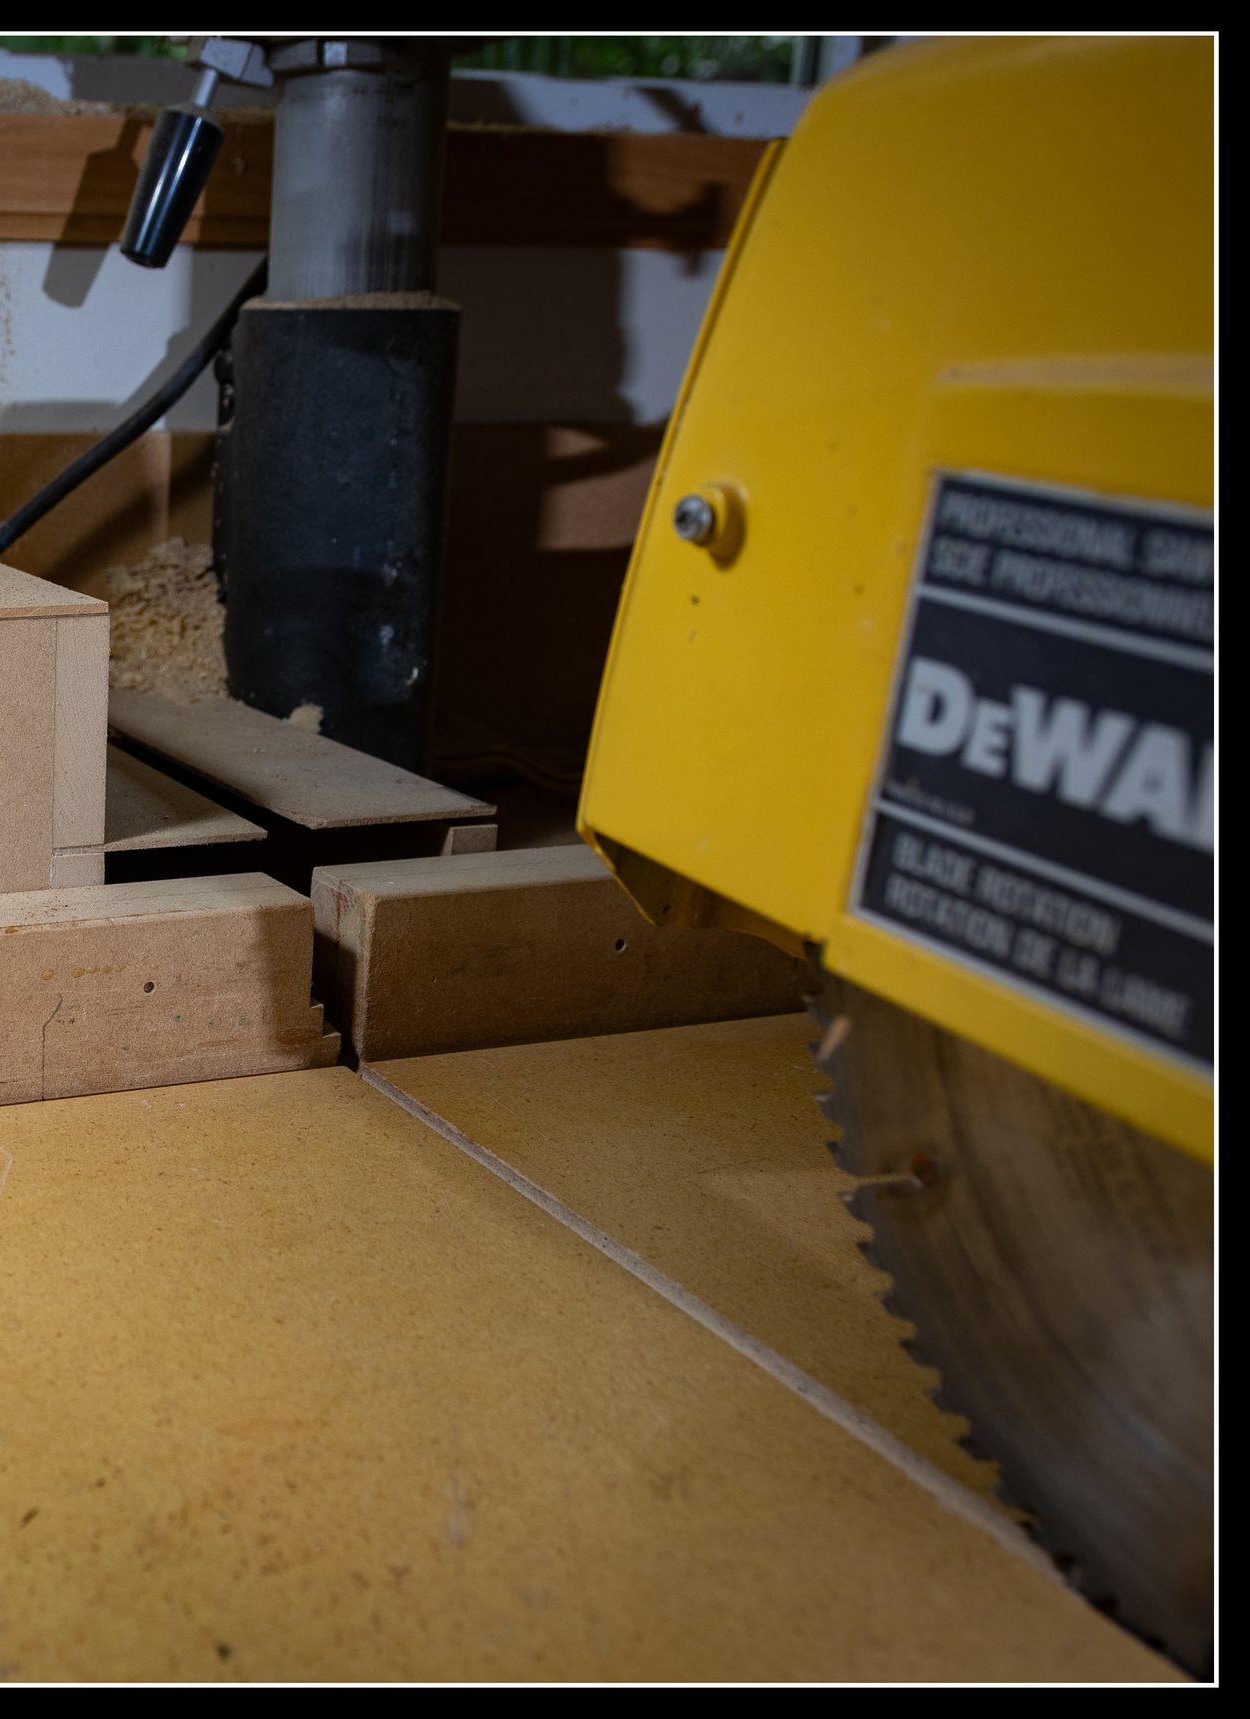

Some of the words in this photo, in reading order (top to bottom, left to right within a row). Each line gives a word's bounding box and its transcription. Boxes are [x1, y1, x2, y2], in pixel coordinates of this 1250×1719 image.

[940, 490, 1135, 571] PROFESSIONAL
[885, 872, 1012, 958] ROTATION
[1011, 926, 1059, 980] DE
[1056, 947, 1100, 999] LA
[894, 831, 975, 896] BLADE
[974, 864, 1120, 956] ROTATION
